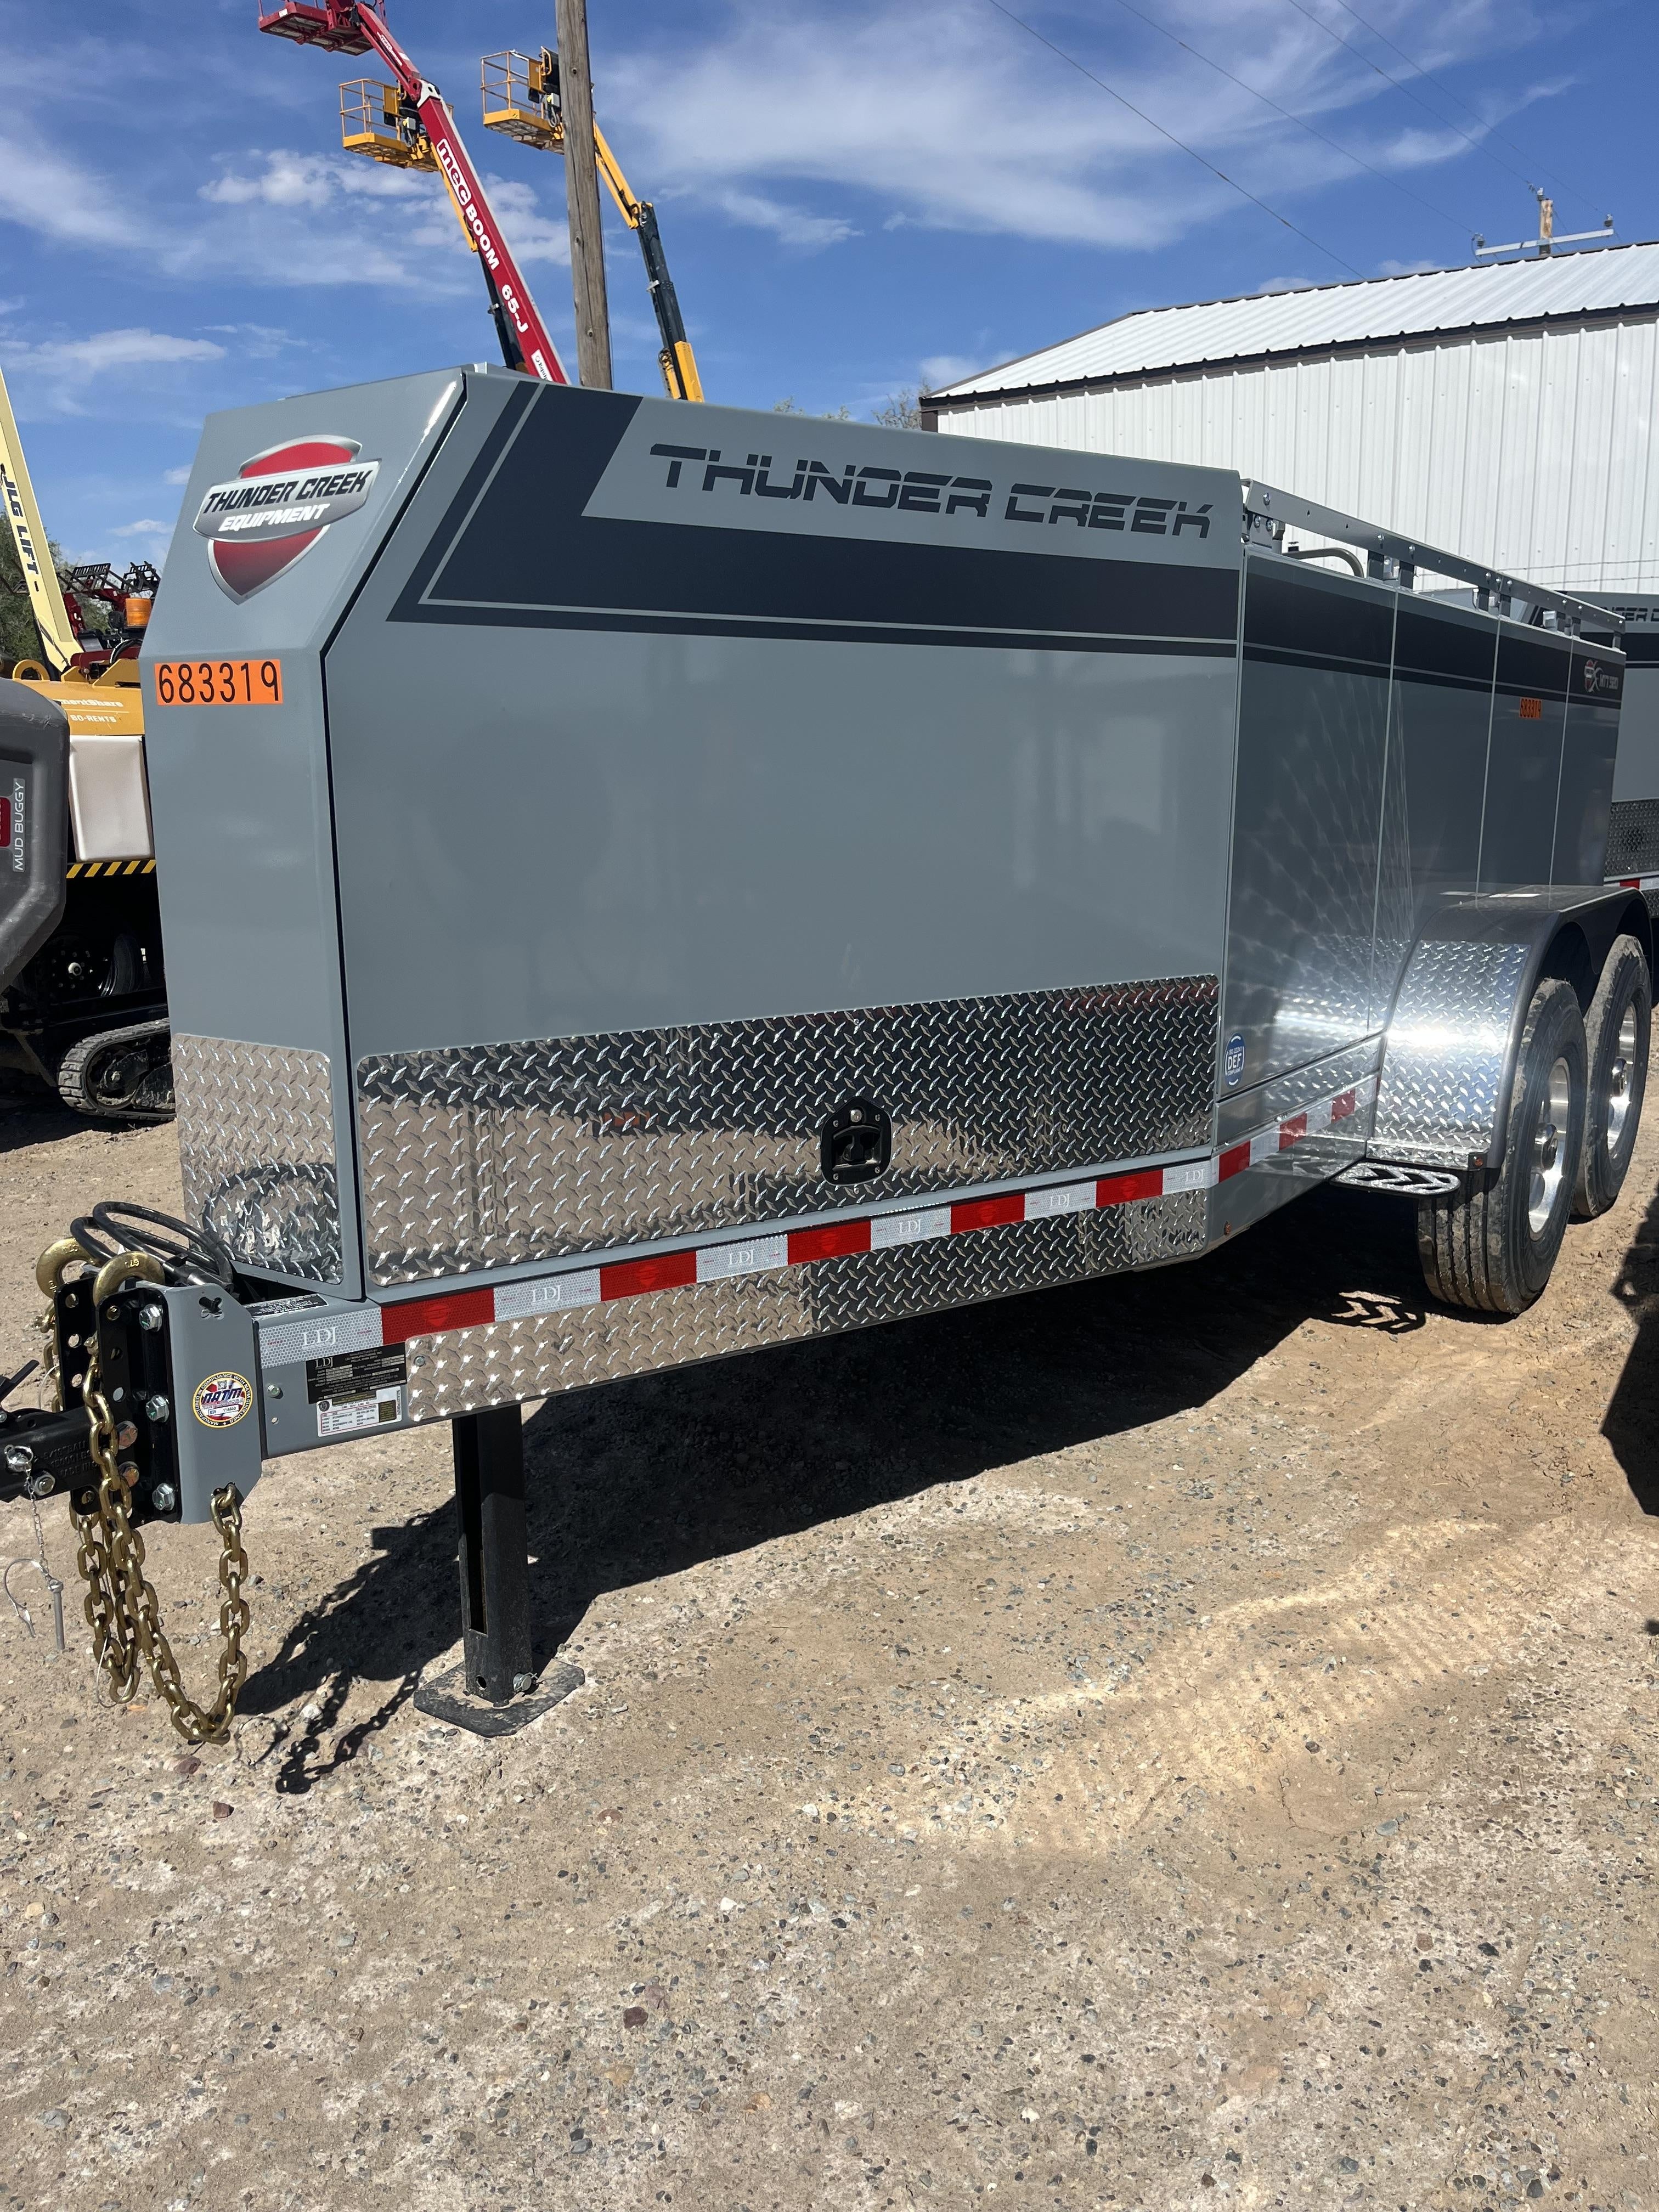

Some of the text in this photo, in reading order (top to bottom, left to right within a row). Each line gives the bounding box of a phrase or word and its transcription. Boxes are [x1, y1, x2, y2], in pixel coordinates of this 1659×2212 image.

[438, 142, 529, 333] mec BOOM 65-J
[203, 470, 374, 514] THUNDER CREEK
[649, 443, 1214, 539] THUNDER CREEK
[3, 476, 39, 575] JLG LIFT
[218, 503, 331, 532] EQUIPMENT
[159, 661, 279, 703] 683319
[14, 782, 24, 871] MUD BUGGY
[1228, 1053, 1242, 1070] DEF
[1184, 1168, 1205, 1182] LDJ
[1049, 1193, 1071, 1208] LDJ
[899, 1218, 922, 1234] LDJ
[729, 1249, 755, 1266] LDJ
[532, 1284, 562, 1303] LDJ
[302, 1326, 338, 1347] LDJ
[315, 1356, 334, 1368] LDJ
